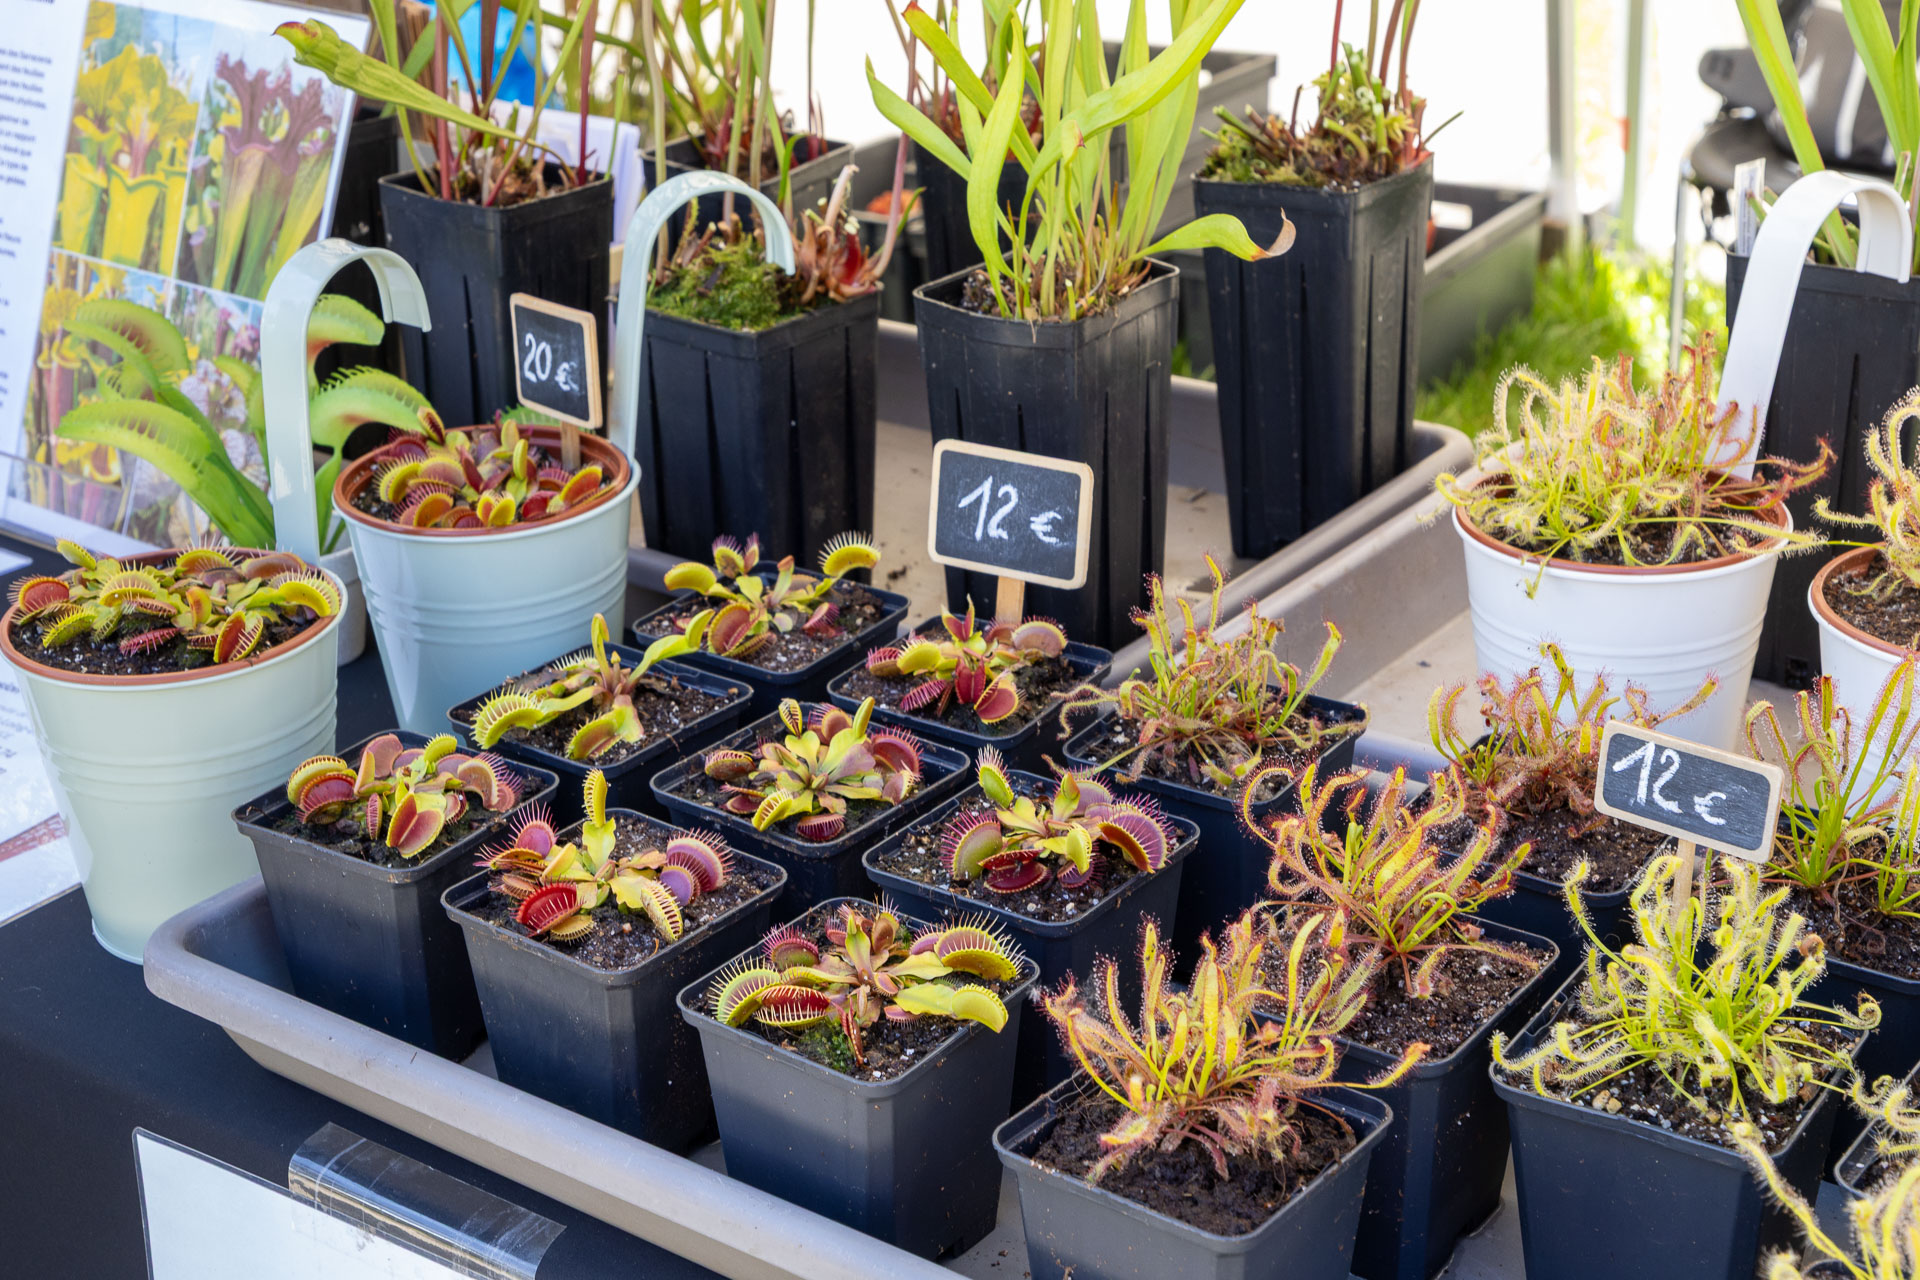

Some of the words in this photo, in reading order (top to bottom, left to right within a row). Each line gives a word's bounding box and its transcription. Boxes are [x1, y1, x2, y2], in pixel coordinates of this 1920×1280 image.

[524, 332, 553, 383] 20
[555, 362, 580, 392] €
[958, 475, 1018, 541] 12
[1030, 510, 1063, 544] €
[1612, 741, 1684, 814] 12
[1693, 791, 1727, 826] €
